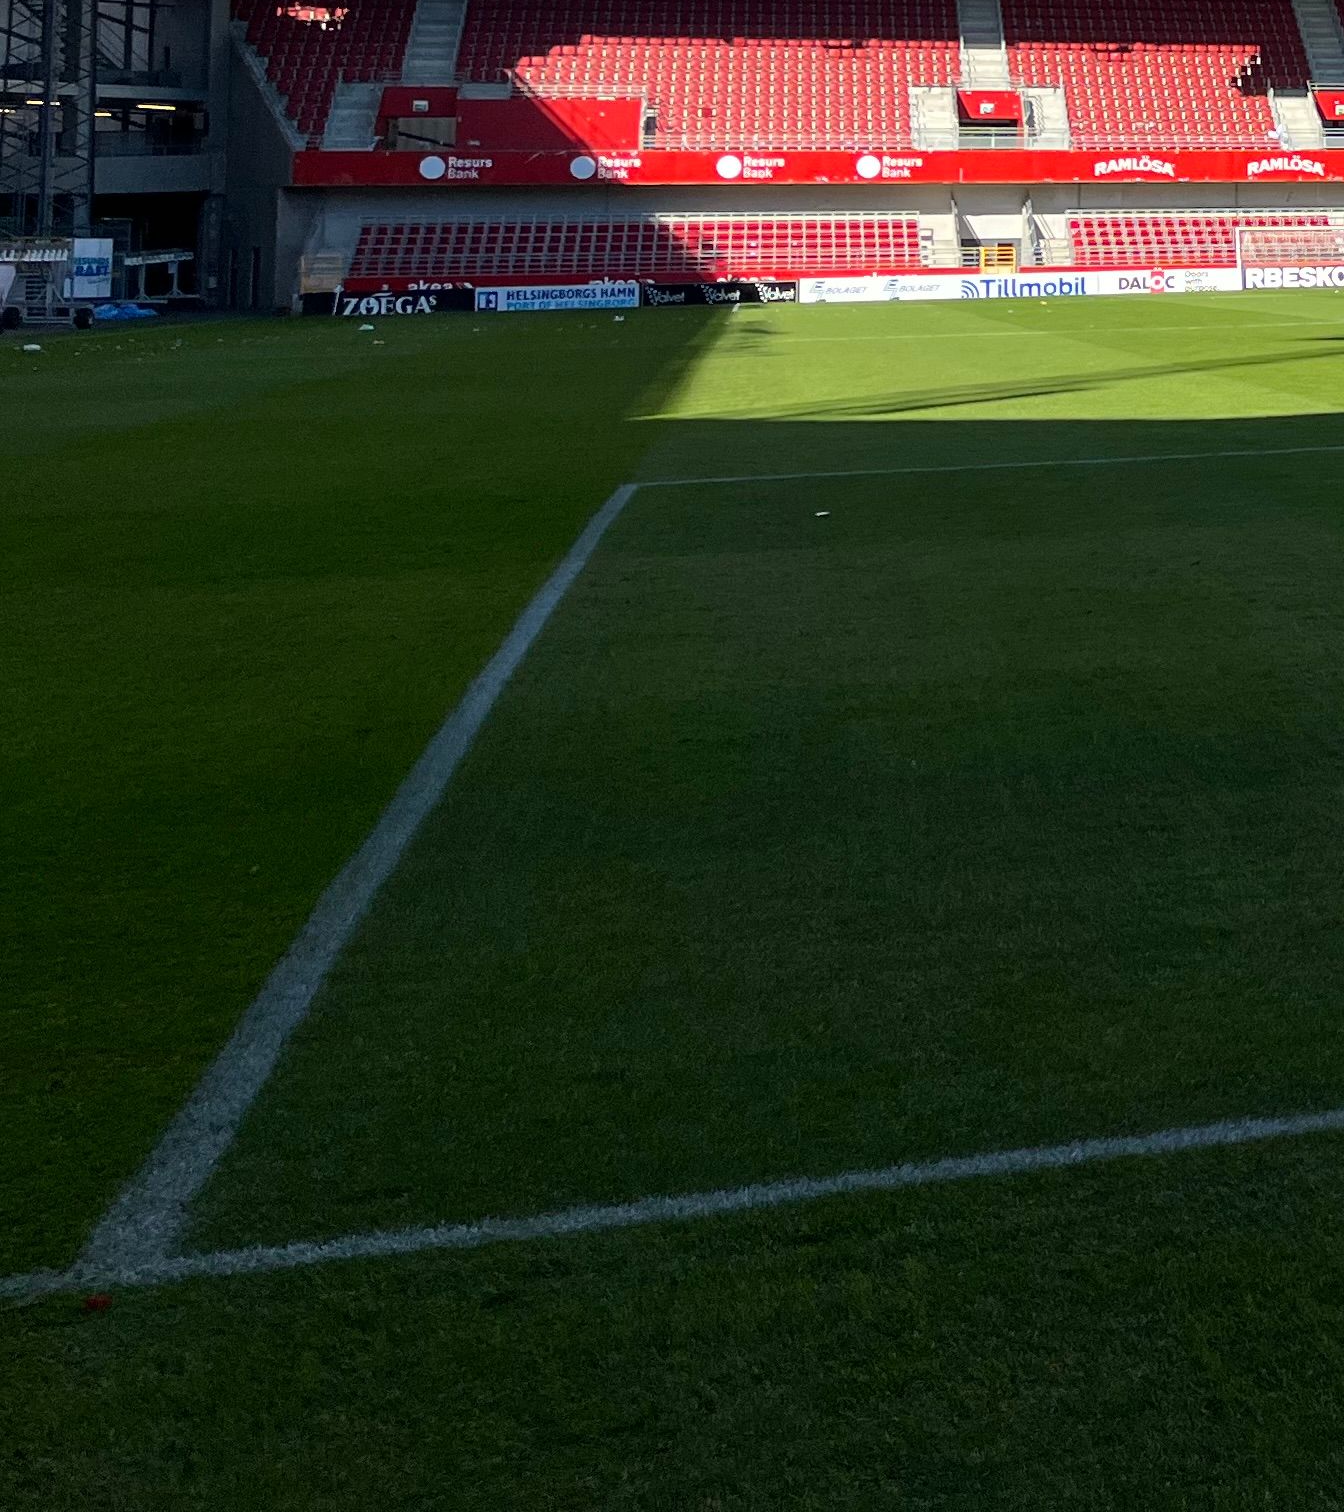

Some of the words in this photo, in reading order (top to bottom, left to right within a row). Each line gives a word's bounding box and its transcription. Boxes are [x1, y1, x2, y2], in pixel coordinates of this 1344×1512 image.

[448, 156, 492, 168] Resurs
[597, 156, 641, 168] Resurs
[743, 156, 785, 167] Resurs
[882, 156, 923, 167] Resurs
[1094, 155, 1175, 176] RAMLÖSA
[1247, 155, 1324, 176] RAMLÖSA
[448, 168, 479, 179] Bank
[597, 167, 628, 179] Bank
[743, 167, 773, 178] Bank
[882, 167, 911, 178] Bank
[980, 277, 1087, 298] Tillmobil
[506, 288, 597, 301] HELSINGBORGS
[603, 287, 636, 298] HAMN
